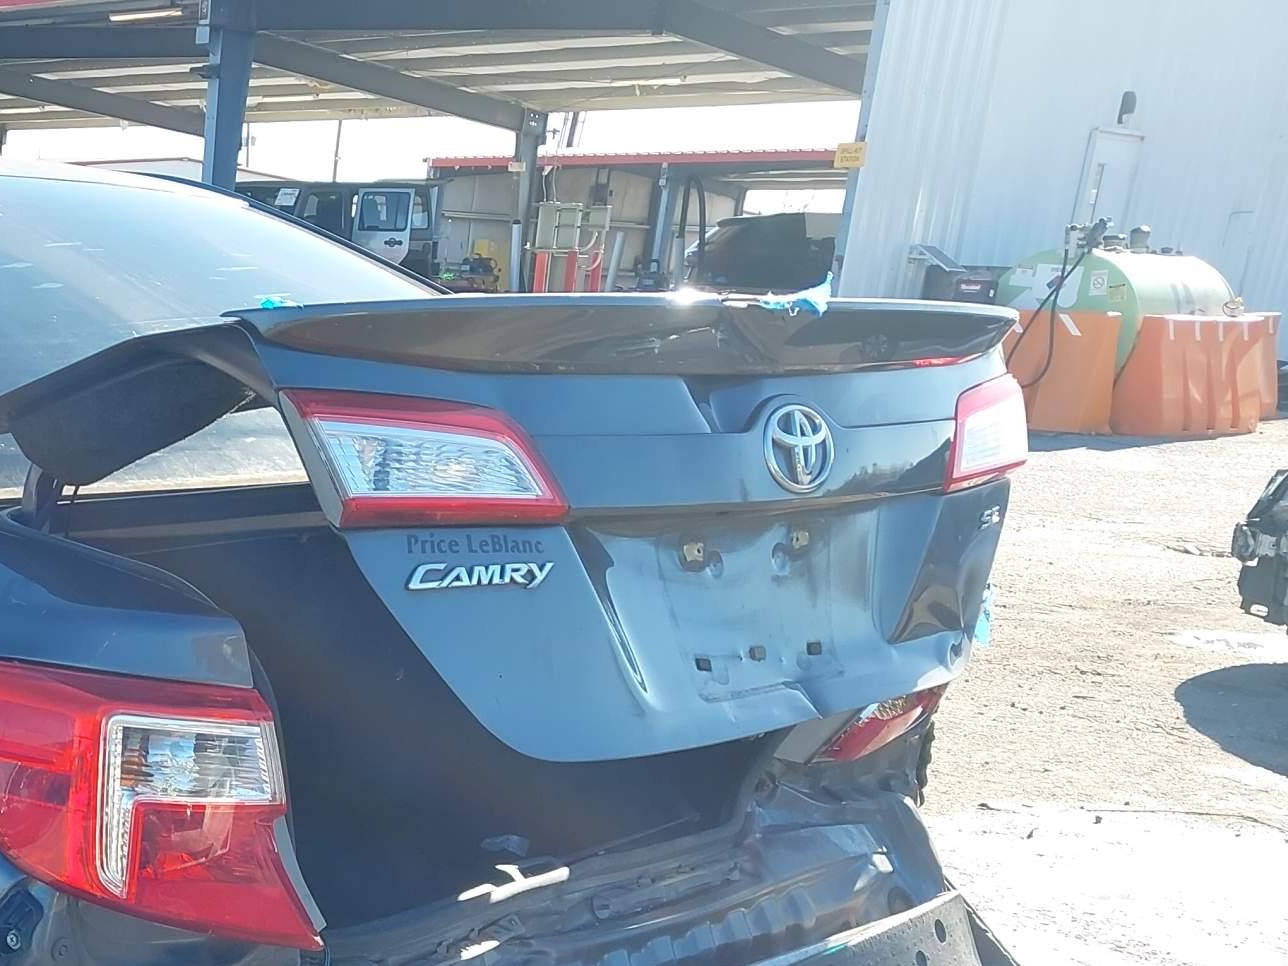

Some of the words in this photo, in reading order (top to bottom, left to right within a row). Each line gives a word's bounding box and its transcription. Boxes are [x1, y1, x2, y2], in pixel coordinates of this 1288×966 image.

[980, 505, 1000, 530] SE
[406, 532, 460, 555] Price
[466, 533, 545, 555] LeBlanc
[407, 562, 555, 591] CAMRY
